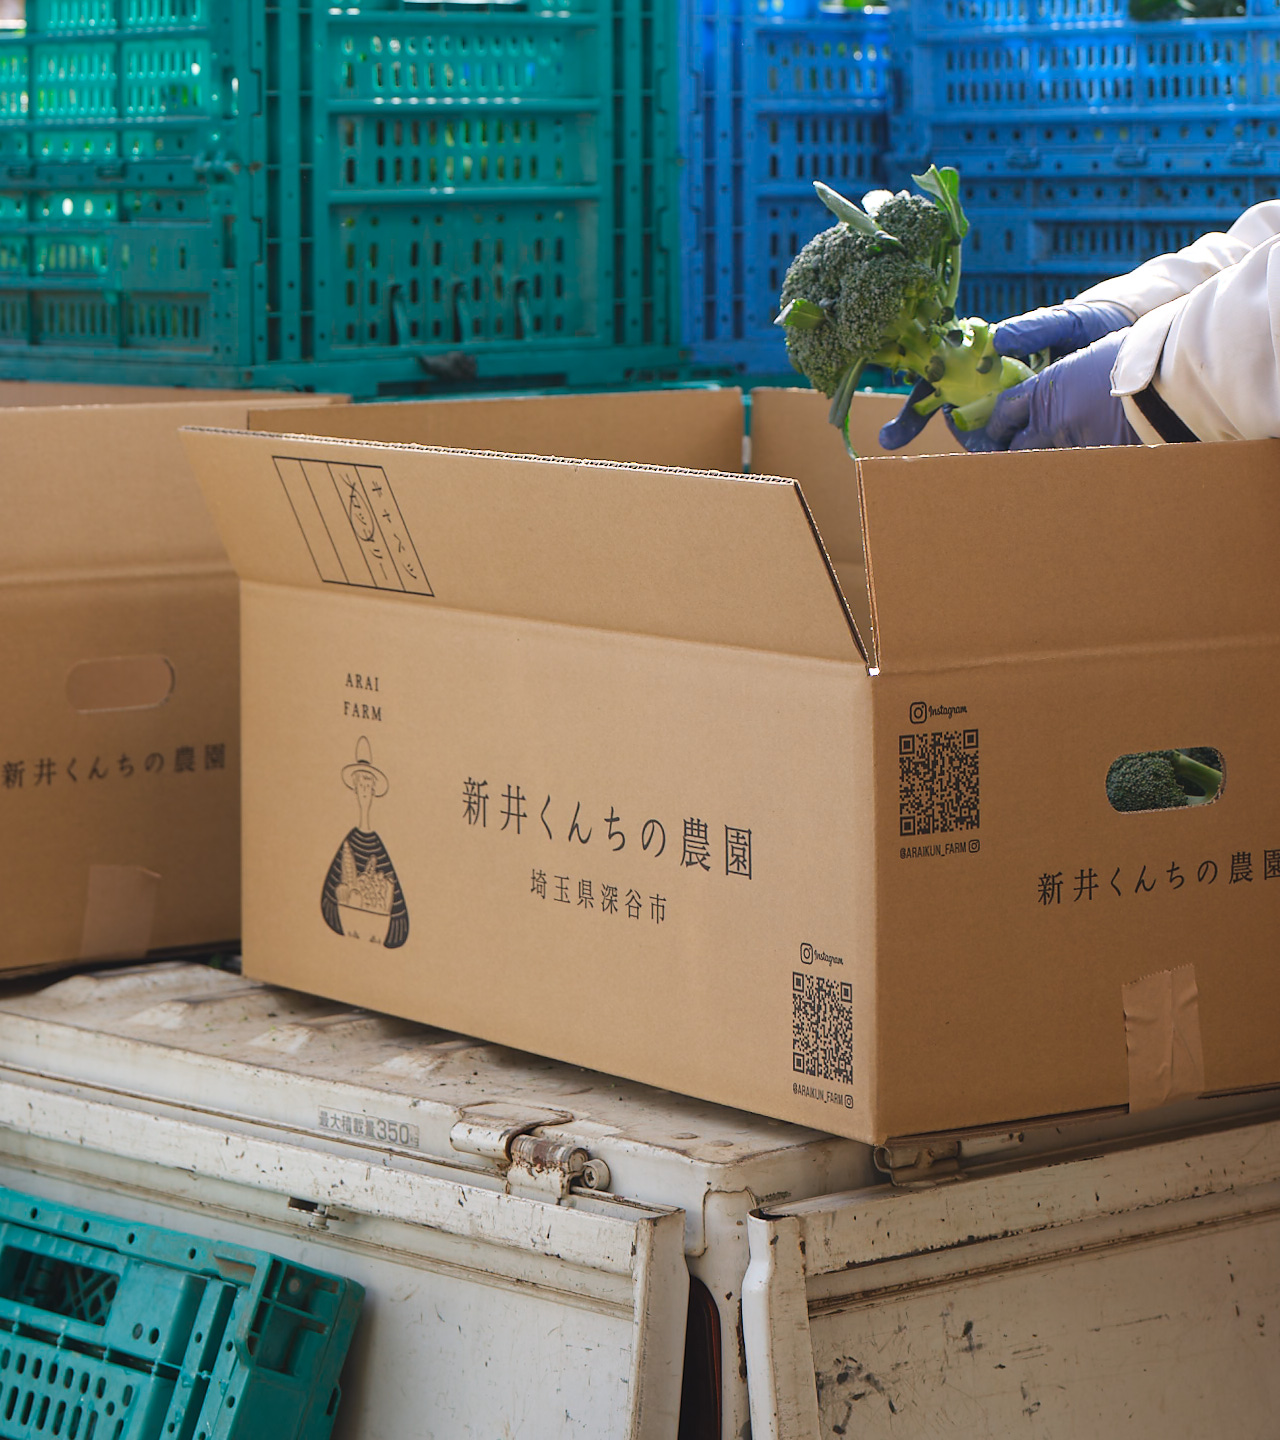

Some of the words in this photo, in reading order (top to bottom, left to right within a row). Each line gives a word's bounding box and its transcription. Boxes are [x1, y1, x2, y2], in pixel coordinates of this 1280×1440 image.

[371, 480, 418, 580] キャベツ
[345, 673, 380, 693] ARAI
[343, 701, 383, 722] FARM
[928, 704, 968, 720] Instagram
[1, 742, 226, 790] 新井くんちの農園
[461, 776, 753, 880] 新井くんちの農園
[899, 841, 967, 860] @ARAIKUN_FARM
[530, 868, 668, 925] 埼玉県深谷市
[813, 948, 844, 967] Instagram
[792, 1082, 844, 1106] @ARAIKUN_FARM
